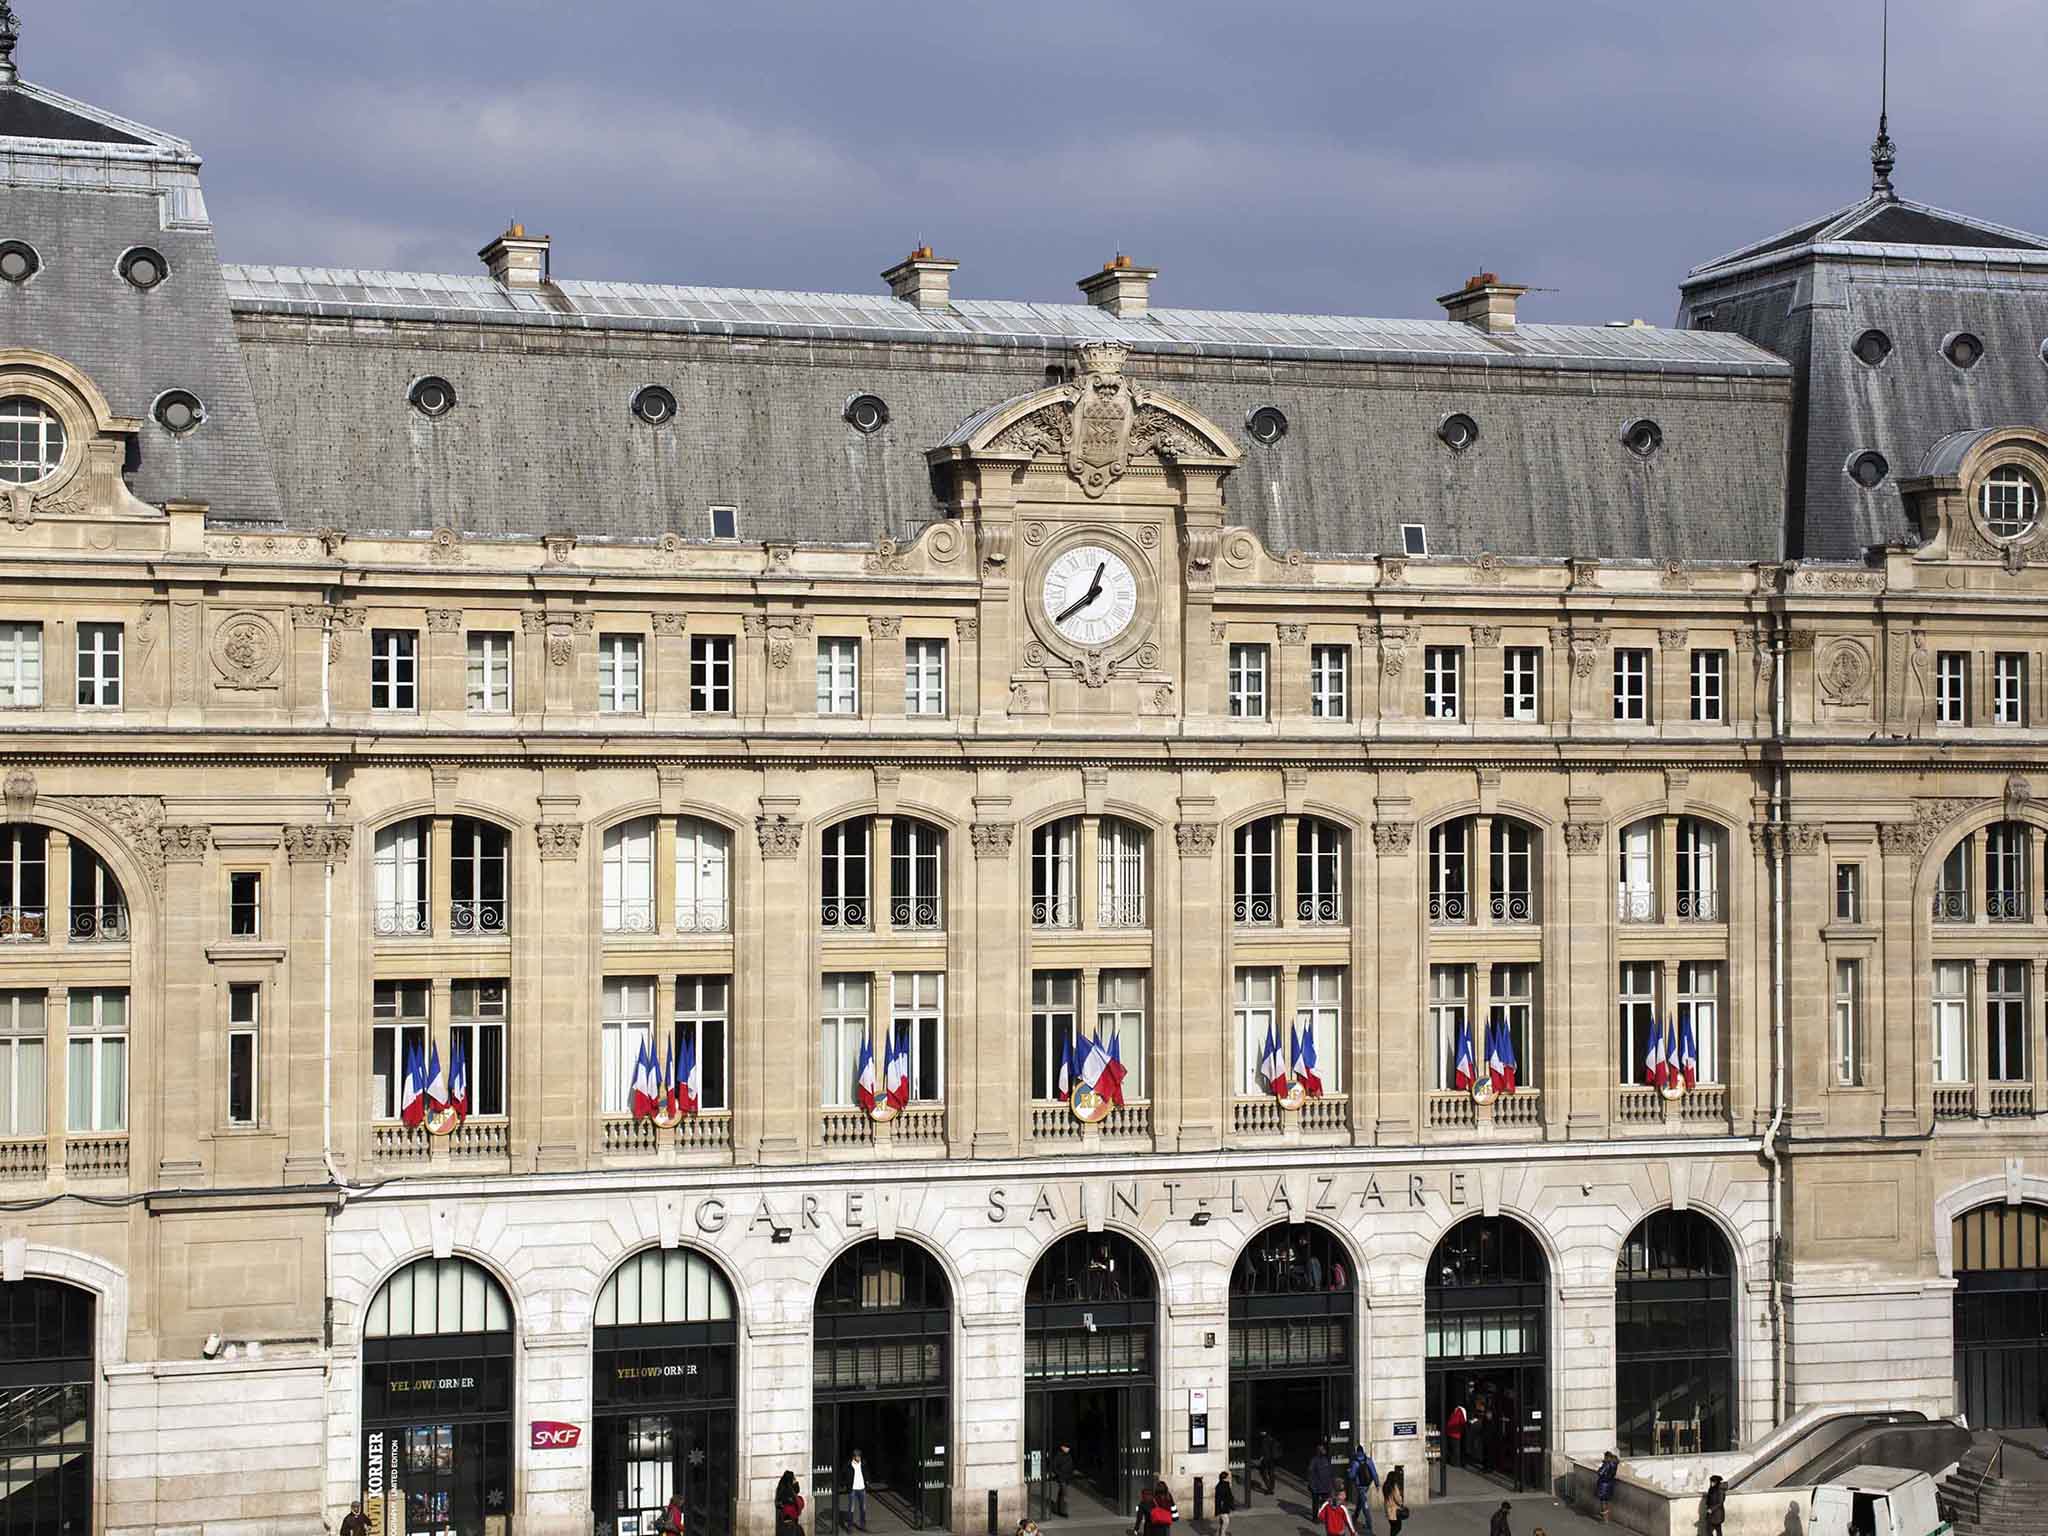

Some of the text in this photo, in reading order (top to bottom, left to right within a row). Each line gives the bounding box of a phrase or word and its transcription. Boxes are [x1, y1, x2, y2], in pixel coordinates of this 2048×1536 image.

[695, 1192, 864, 1233] GARE
[533, 1429, 579, 1445] SNCF
[391, 1440, 399, 1468] EDITION
